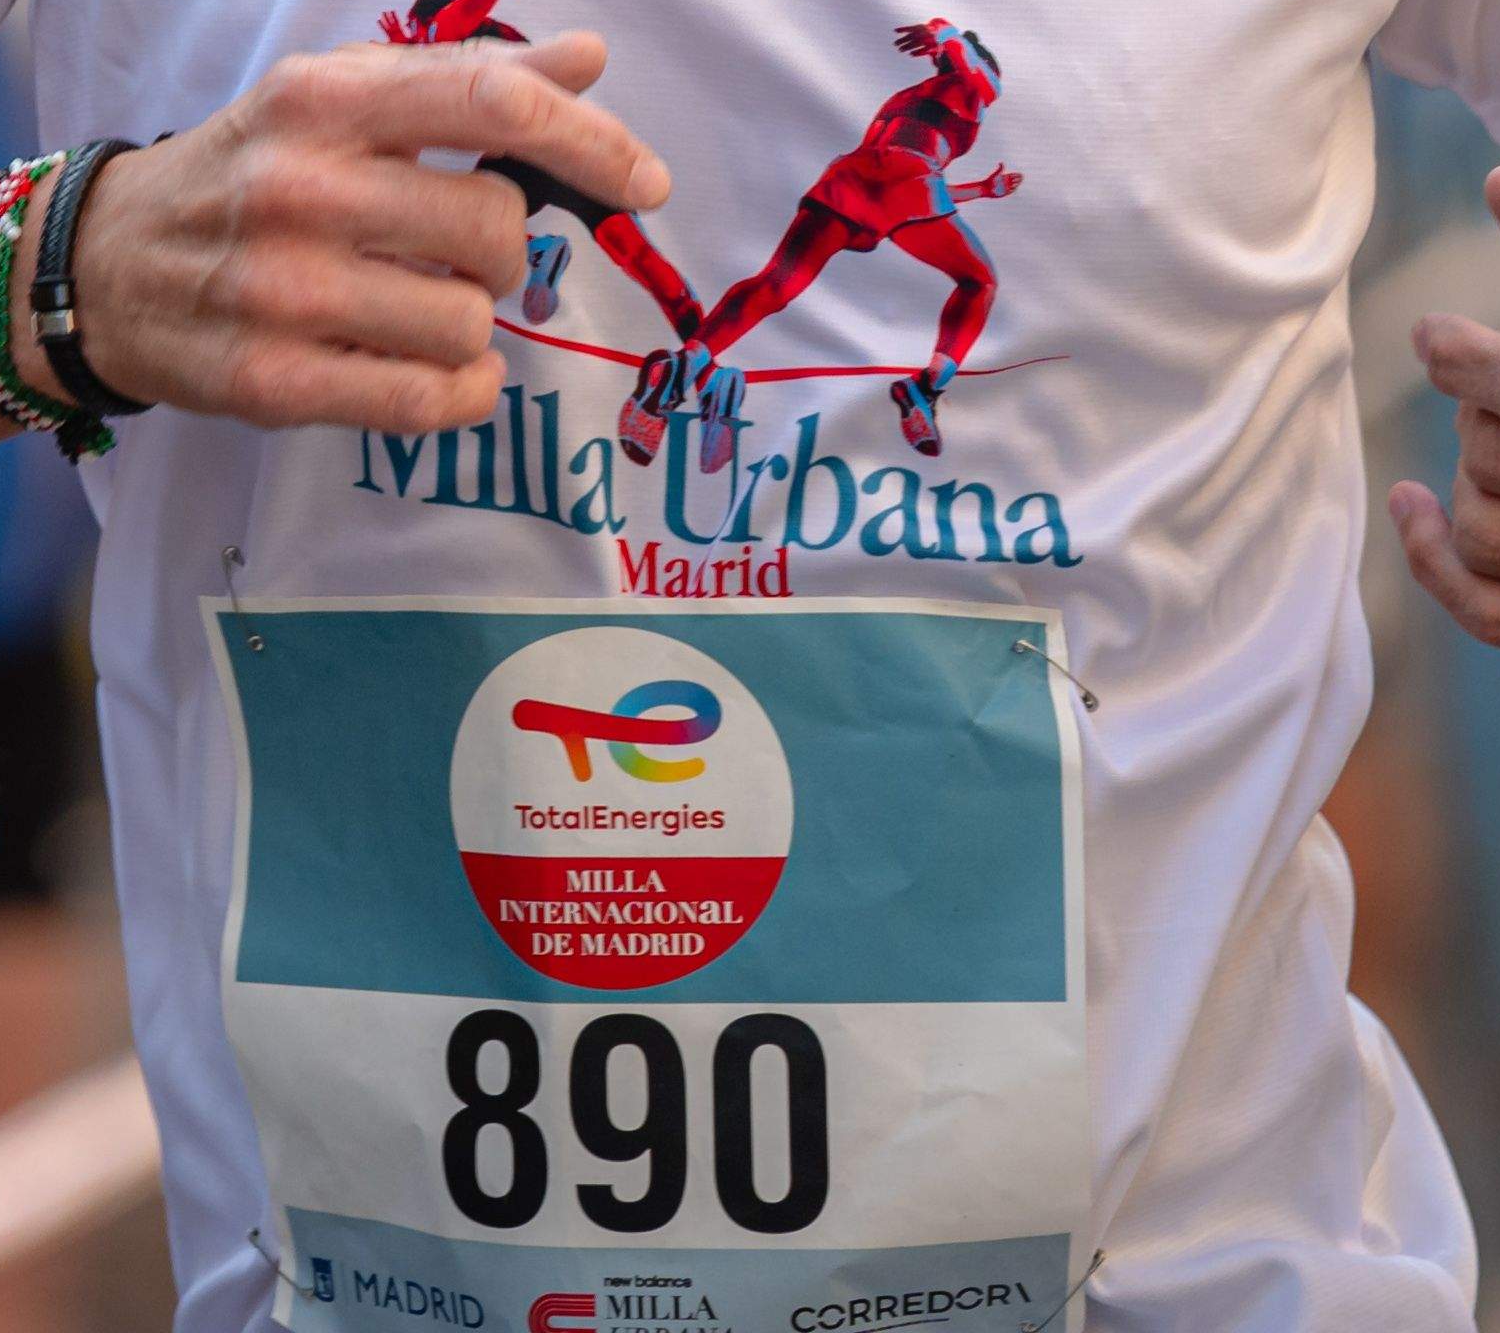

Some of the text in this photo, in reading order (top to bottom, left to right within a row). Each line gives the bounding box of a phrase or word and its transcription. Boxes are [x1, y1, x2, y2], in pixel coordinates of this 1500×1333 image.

[353, 384, 627, 535] Milla
[662, 410, 1084, 568] Urbana
[513, 803, 726, 837] TotalEnergies
[565, 869, 667, 894] MILLA
[531, 933, 706, 956] DE MADRID
[442, 1008, 831, 1235] 890
[603, 1274, 694, 1288] new balance
[353, 1269, 485, 1329] MADRID
[605, 1294, 719, 1320] MILLA
